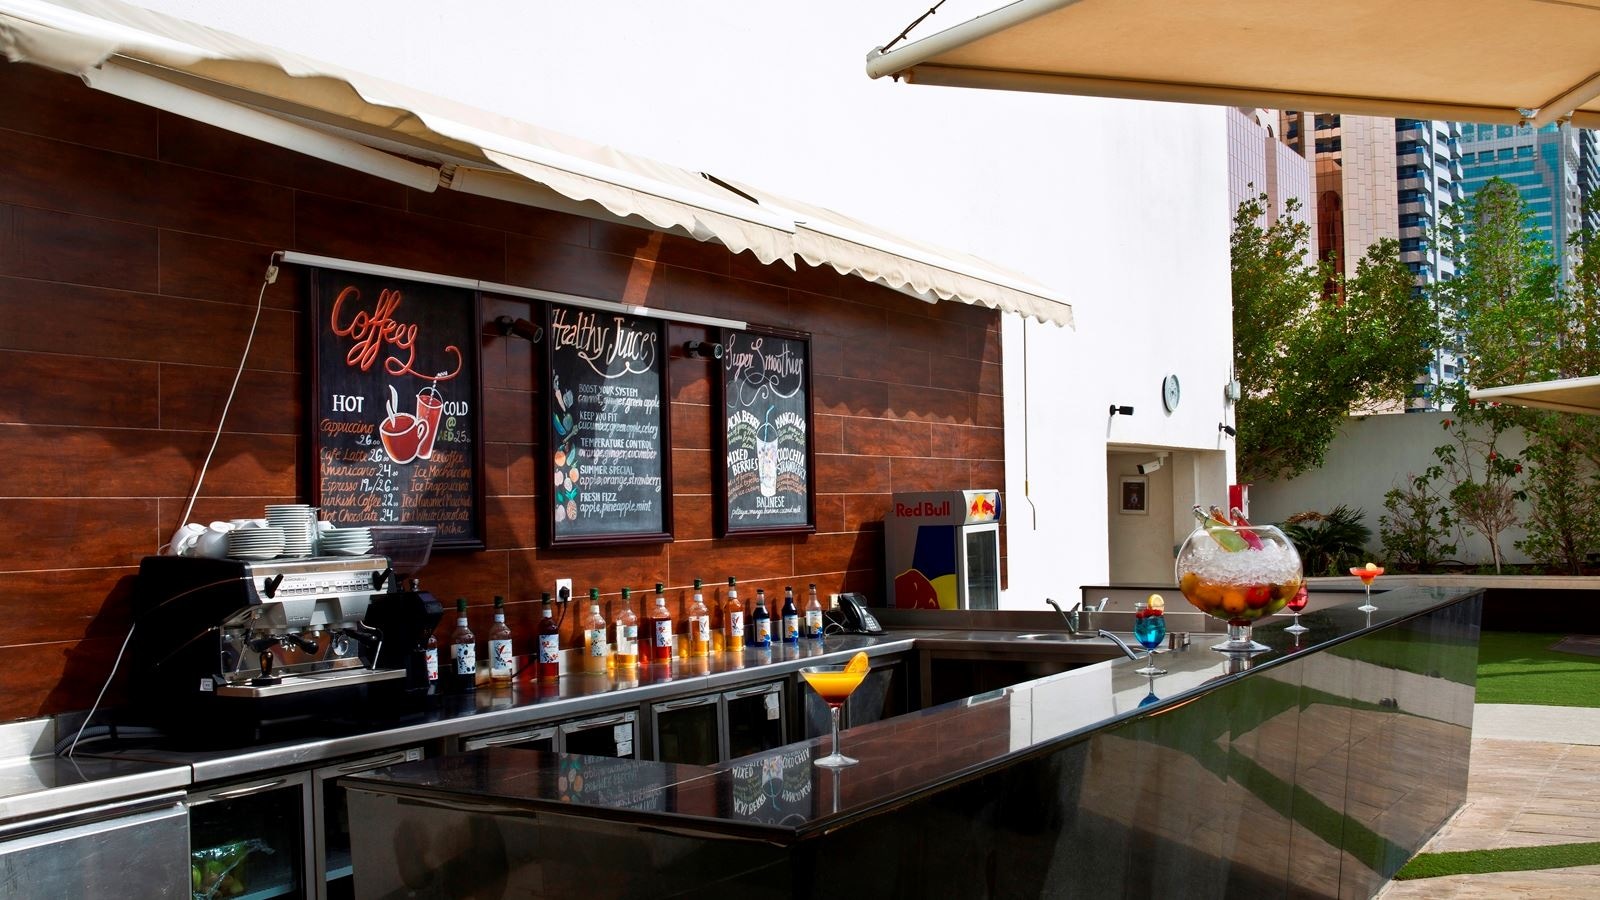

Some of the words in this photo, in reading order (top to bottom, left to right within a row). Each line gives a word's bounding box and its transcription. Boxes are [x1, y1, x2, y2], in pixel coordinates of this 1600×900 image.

[331, 286, 420, 376] Coffee
[552, 308, 609, 361] Healthy
[606, 317, 657, 366] Juices
[725, 333, 754, 382] Super
[578, 383, 598, 394] BOOST
[598, 385, 614, 397] YOUR
[615, 386, 639, 398] SYSTEM
[332, 394, 365, 413] HOT
[443, 401, 468, 416] COLD
[445, 416, 457, 431] @
[580, 411, 595, 421] KEEP
[595, 412, 607, 422] YOU
[607, 412, 618, 422] FIT
[741, 409, 761, 430] BERRY
[320, 418, 375, 438] Cappuccino
[580, 437, 625, 448] TEMPERATURE
[625, 439, 653, 450] CONTROL
[727, 448, 749, 468] MIXED
[320, 462, 377, 477] Americano
[580, 465, 608, 475] SUMMER
[608, 466, 635, 476] SPECIAL
[731, 458, 759, 477] BERRIES
[320, 477, 358, 493] Espresso
[320, 492, 356, 507] Turkish
[357, 492, 381, 513] Coffee
[580, 492, 601, 502] FRESH
[601, 492, 618, 502] FIZZ
[756, 495, 785, 509] BALINESE
[338, 508, 379, 522] Chocolate
[895, 501, 922, 518] Red
[924, 500, 951, 517] Bull
